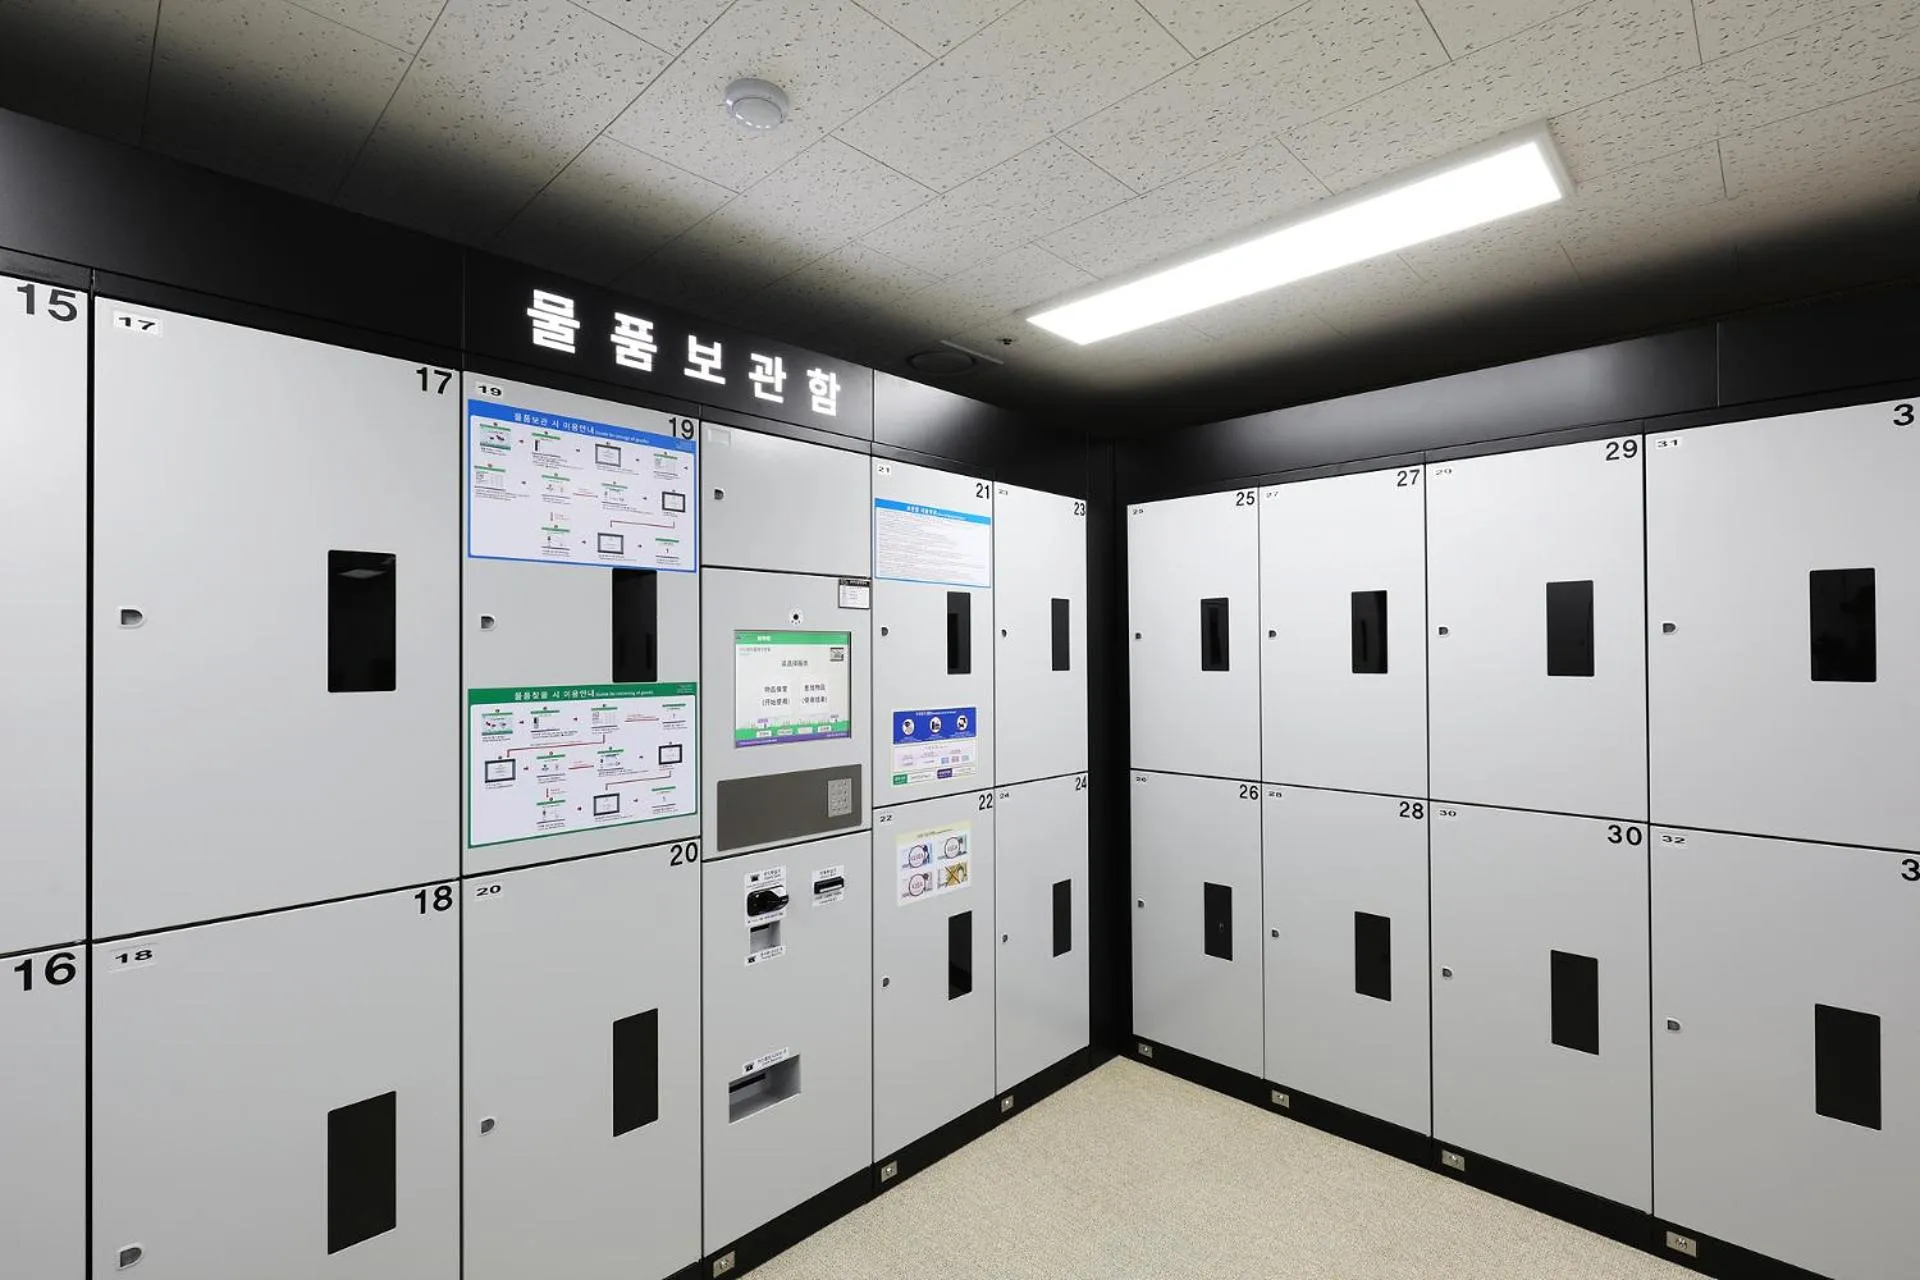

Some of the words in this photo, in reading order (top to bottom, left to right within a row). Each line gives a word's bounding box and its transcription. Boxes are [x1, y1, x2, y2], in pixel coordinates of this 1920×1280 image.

[17, 283, 79, 323] 15
[118, 316, 156, 331] 17
[415, 366, 454, 396] 17
[478, 385, 502, 397] 19
[1892, 403, 1915, 427] 3
[668, 416, 695, 440] 19
[1605, 439, 1638, 462] 29
[1658, 439, 1678, 448] 31
[1396, 469, 1421, 487] 27
[975, 482, 991, 500] 21
[1235, 491, 1256, 507] 25
[1073, 501, 1086, 517] 23
[1074, 775, 1088, 792] 24
[1239, 783, 1260, 801] 26
[978, 792, 994, 811] 22
[1398, 801, 1425, 820] 28
[879, 814, 893, 823] 22
[1607, 824, 1643, 847] 30
[1662, 835, 1685, 844] 32
[669, 841, 699, 867] 20
[1901, 857, 1920, 882] 3
[476, 884, 502, 897] 20
[413, 884, 453, 916] 18
[115, 949, 153, 964] 18
[14, 951, 78, 992] 16
